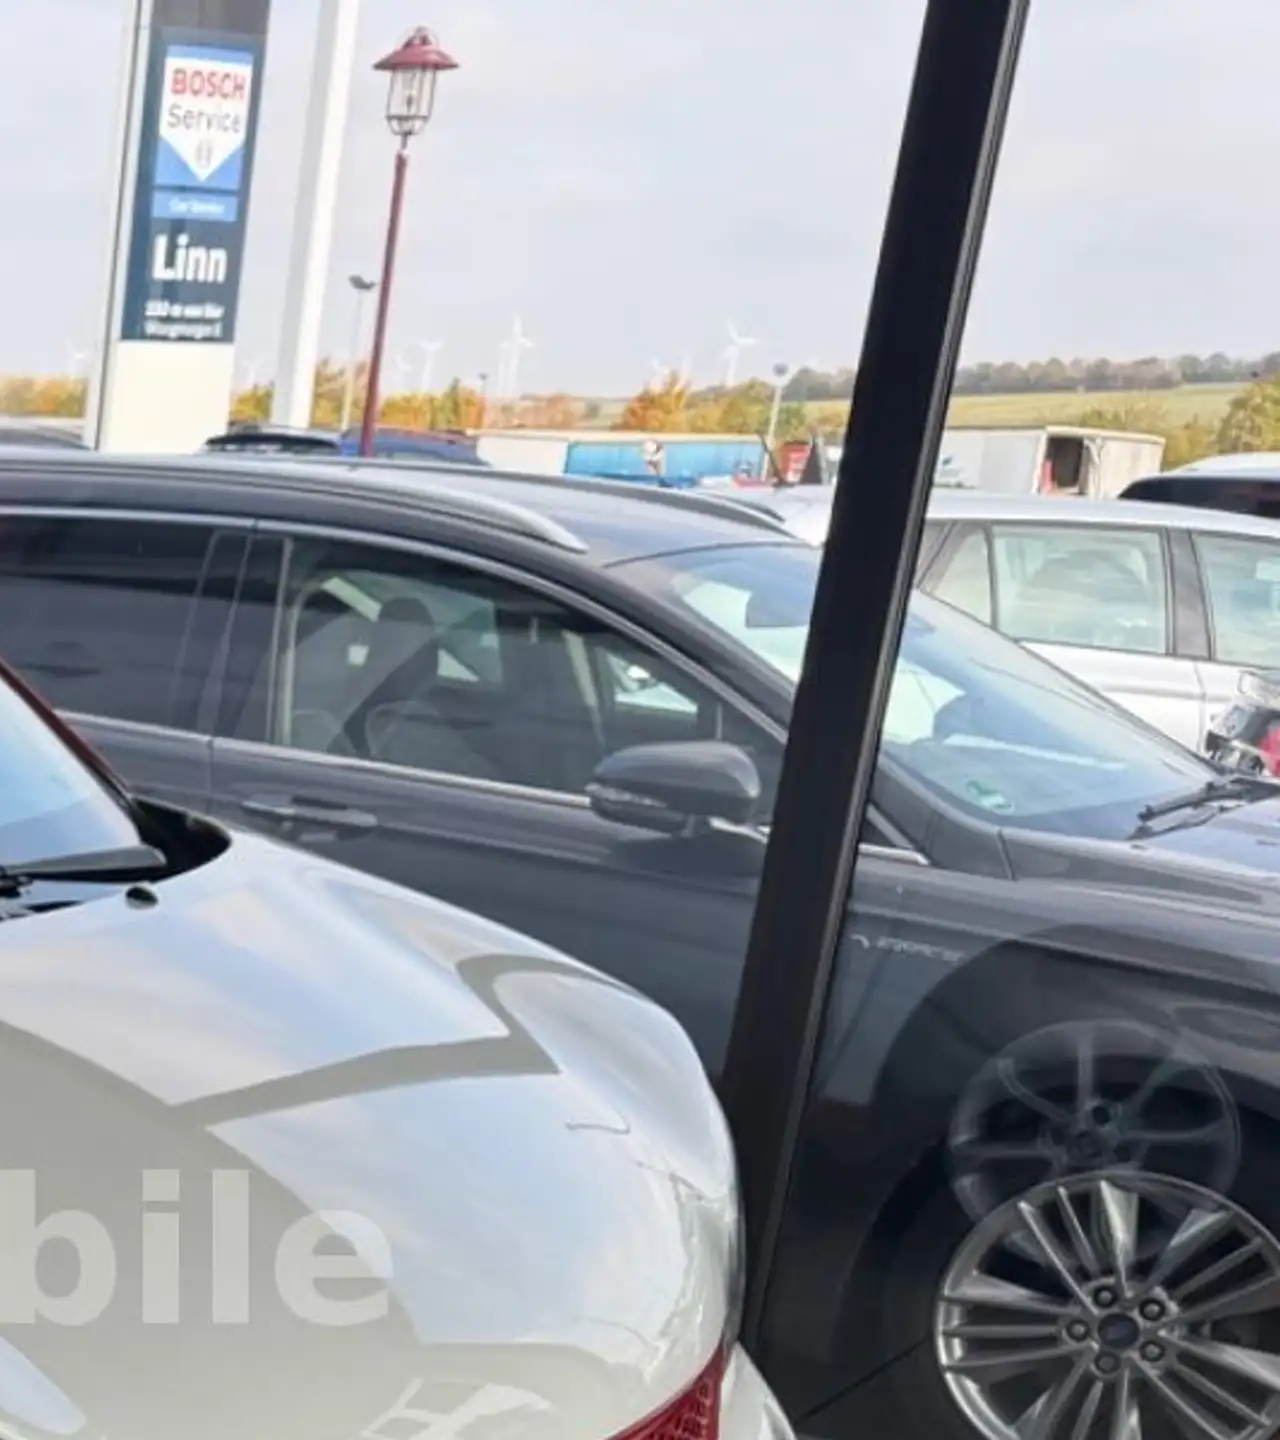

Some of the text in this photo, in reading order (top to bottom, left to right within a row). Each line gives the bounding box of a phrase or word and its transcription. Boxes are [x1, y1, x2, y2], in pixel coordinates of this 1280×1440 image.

[170, 68, 246, 100] BOSCH
[167, 103, 242, 133] Service
[152, 233, 228, 284] Linn
